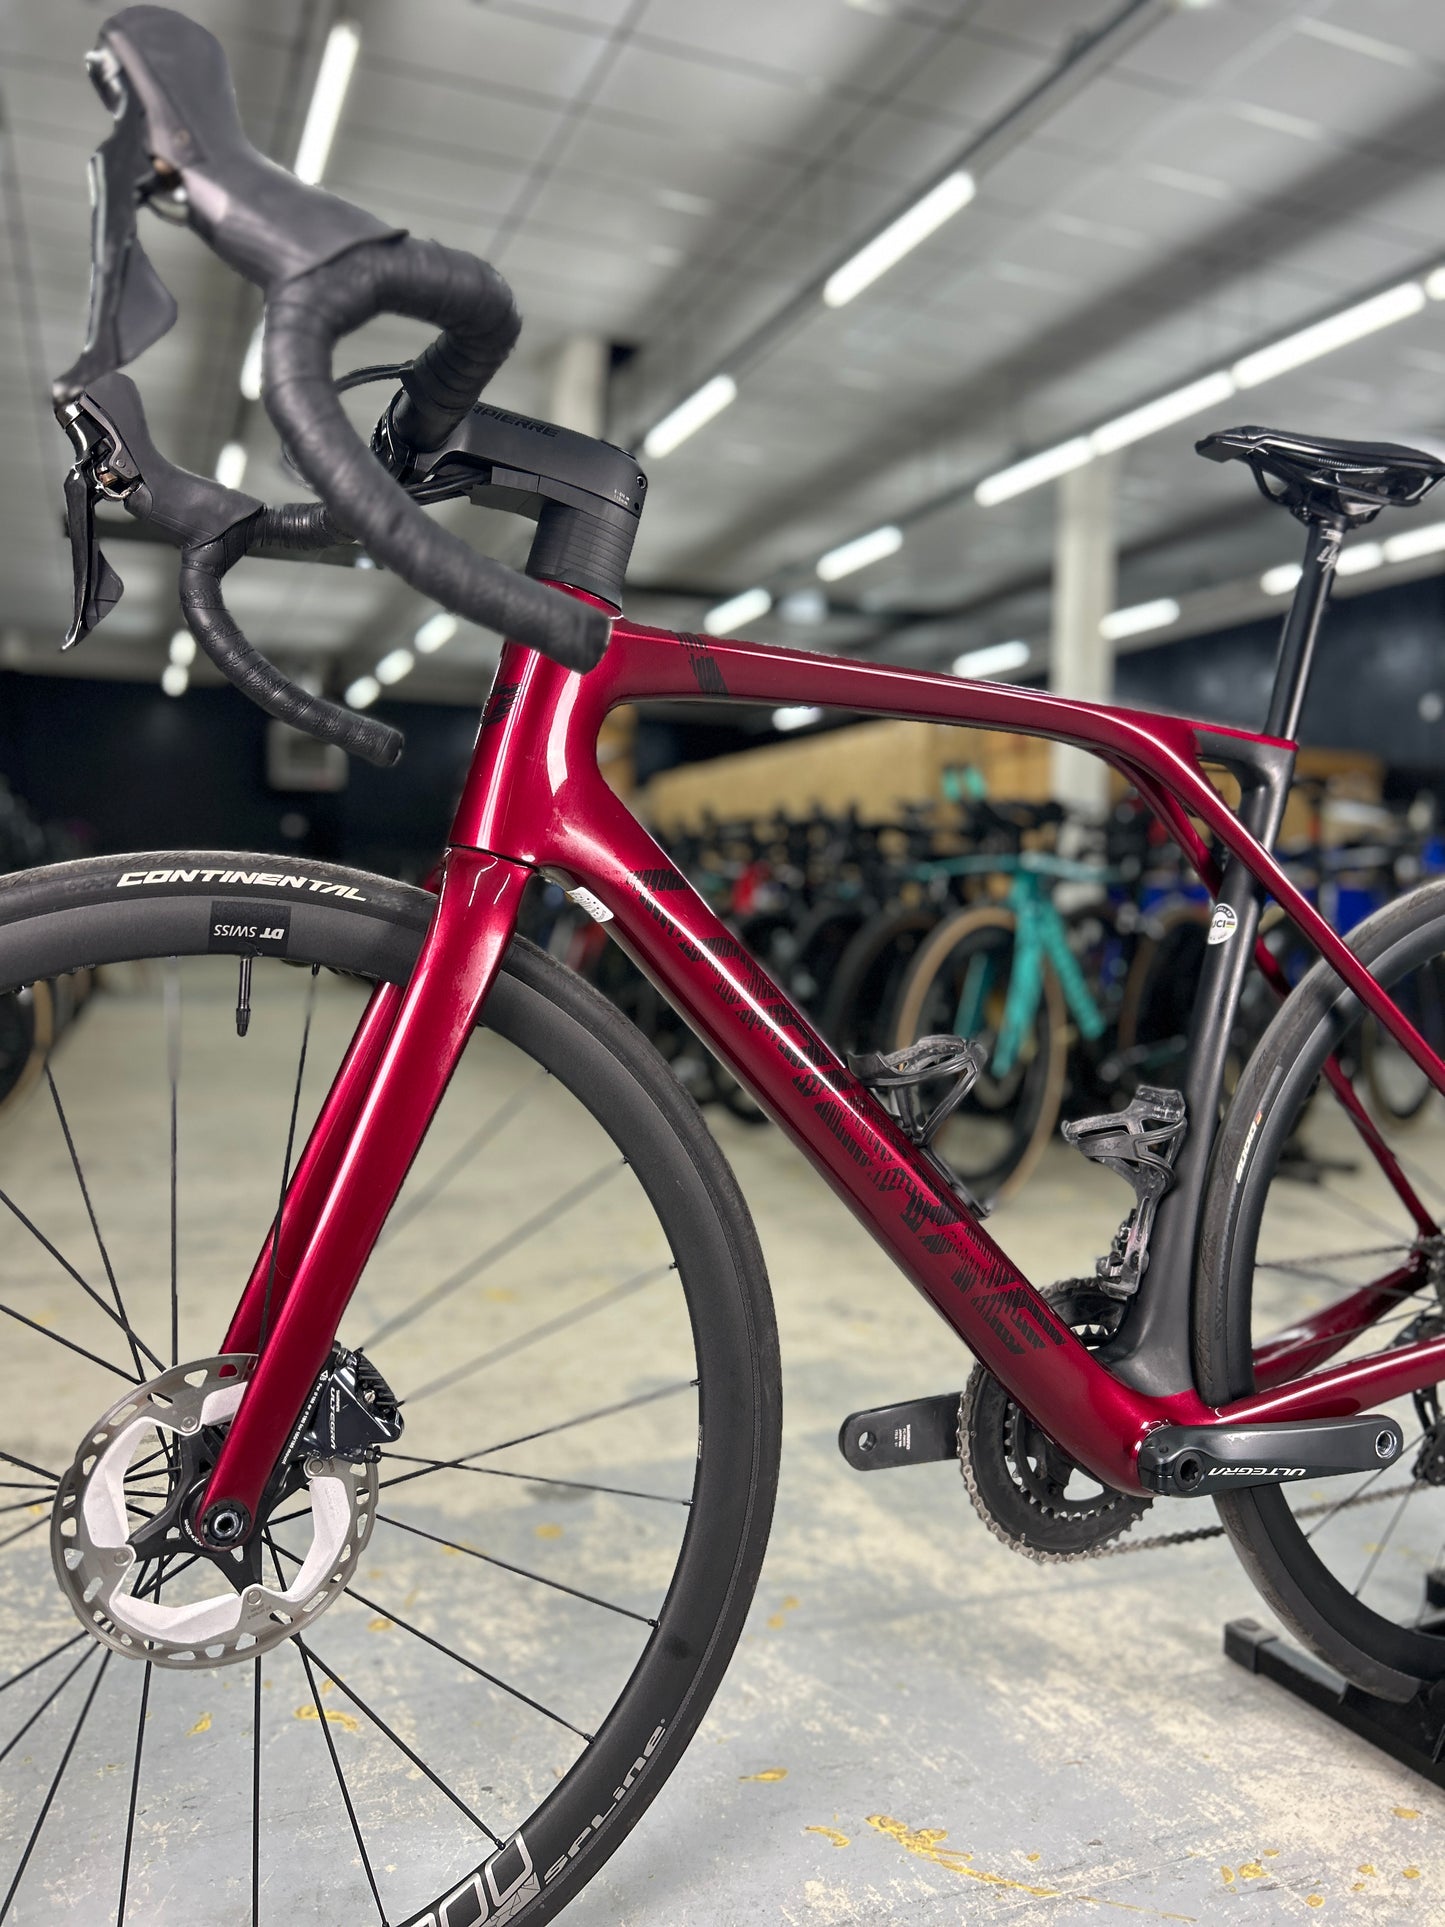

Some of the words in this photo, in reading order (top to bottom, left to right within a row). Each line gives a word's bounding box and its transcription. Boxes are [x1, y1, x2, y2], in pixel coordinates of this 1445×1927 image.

[117, 869, 367, 902] CONTINENTAL
[214, 924, 257, 938] SWISS
[260, 927, 284, 940] DT
[1208, 1467, 1306, 1476] ULTEGRA
[411, 1830, 533, 1927] 00
